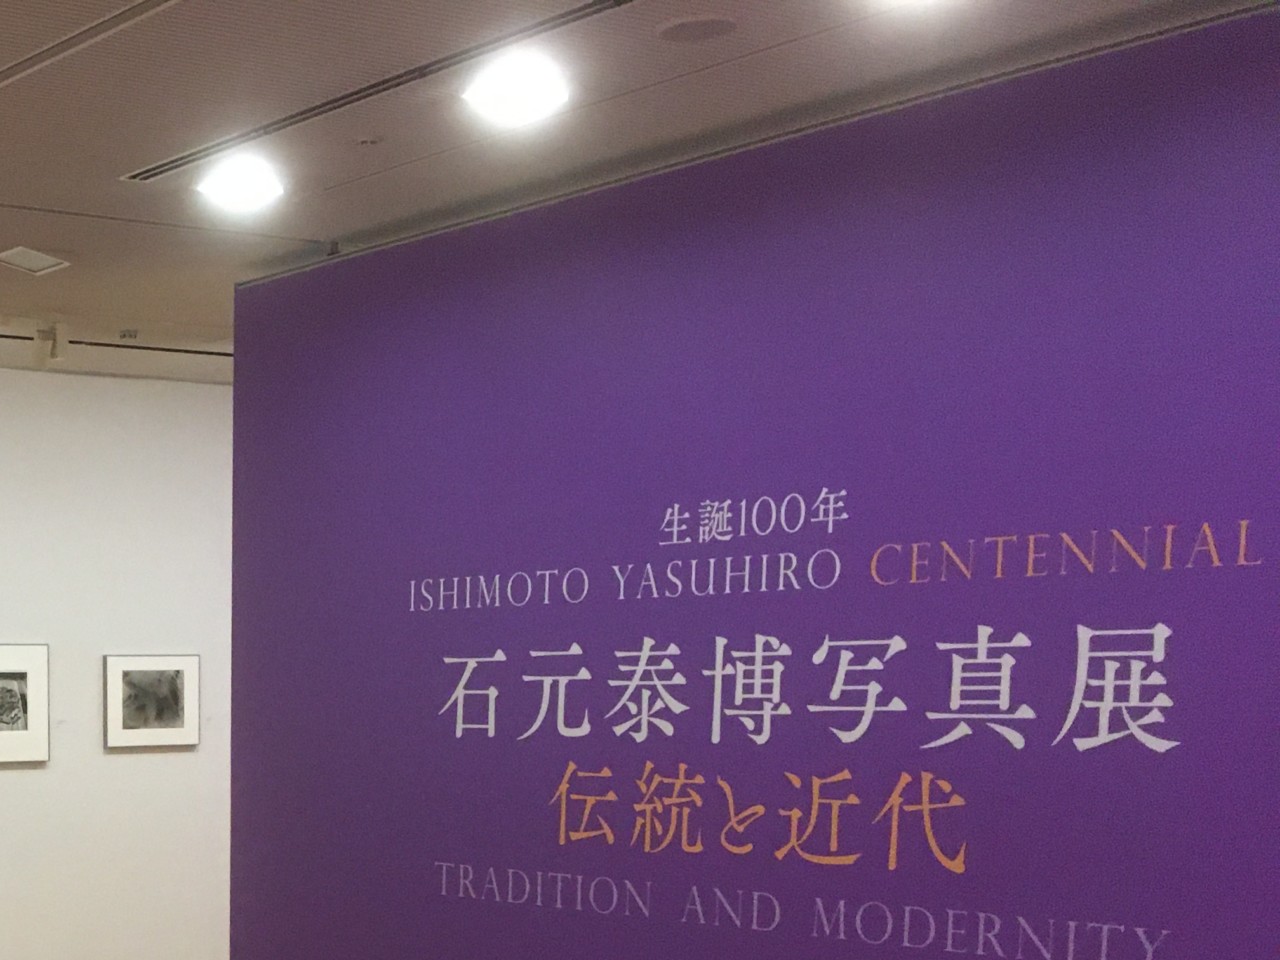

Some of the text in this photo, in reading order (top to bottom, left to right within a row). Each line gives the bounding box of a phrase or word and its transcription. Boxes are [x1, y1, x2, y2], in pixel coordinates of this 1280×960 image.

[658, 487, 850, 547] 生誕100年
[408, 519, 1263, 612] ISHIMOTO YASUHIRO CENTENNIAL
[437, 623, 1182, 753] 石元泰博写真展
[549, 760, 968, 874] 伝統と近代
[434, 861, 652, 919] TRADITION
[681, 885, 782, 933] AND
